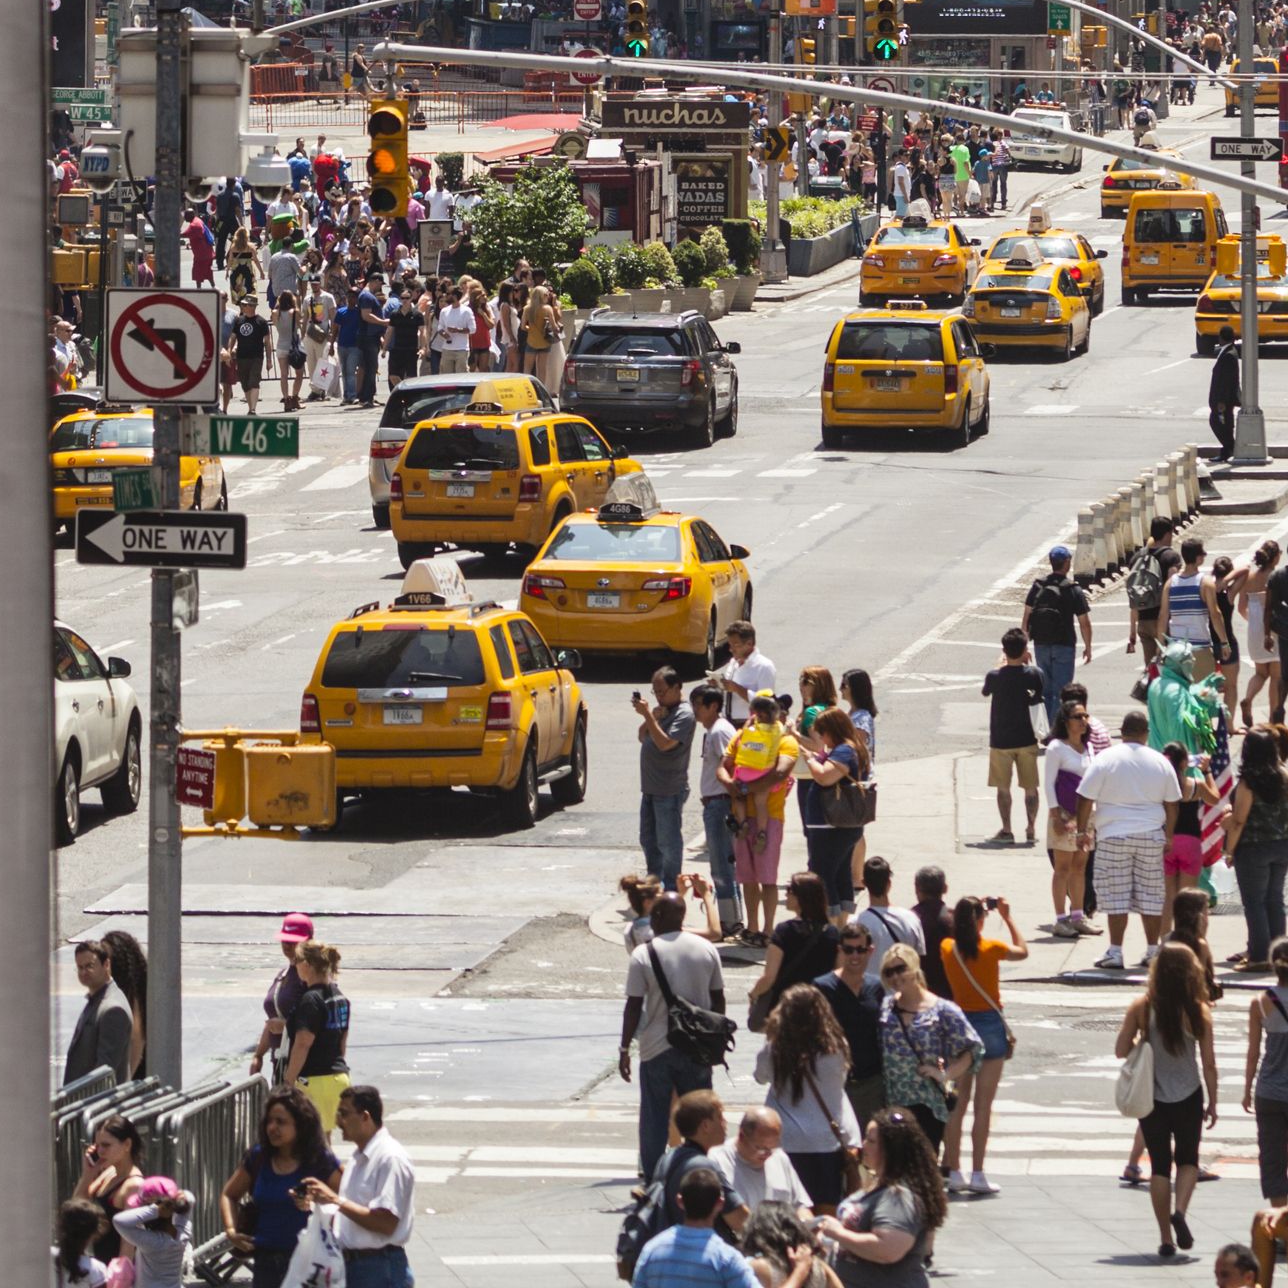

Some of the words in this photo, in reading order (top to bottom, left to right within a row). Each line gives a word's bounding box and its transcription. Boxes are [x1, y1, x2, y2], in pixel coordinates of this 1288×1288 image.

[71, 106, 83, 119] W
[86, 106, 102, 119] 45
[623, 103, 727, 125] nuchas
[1220, 144, 1242, 154] ONE
[1251, 144, 1273, 155] WAY
[82, 155, 109, 172] NYPD
[681, 182, 725, 190] BAKED
[216, 420, 234, 452] W
[240, 421, 268, 453] 46
[275, 422, 294, 439] ST
[122, 527, 167, 550] ONE
[180, 530, 228, 552] WAY
[407, 594, 432, 604] 1V66
